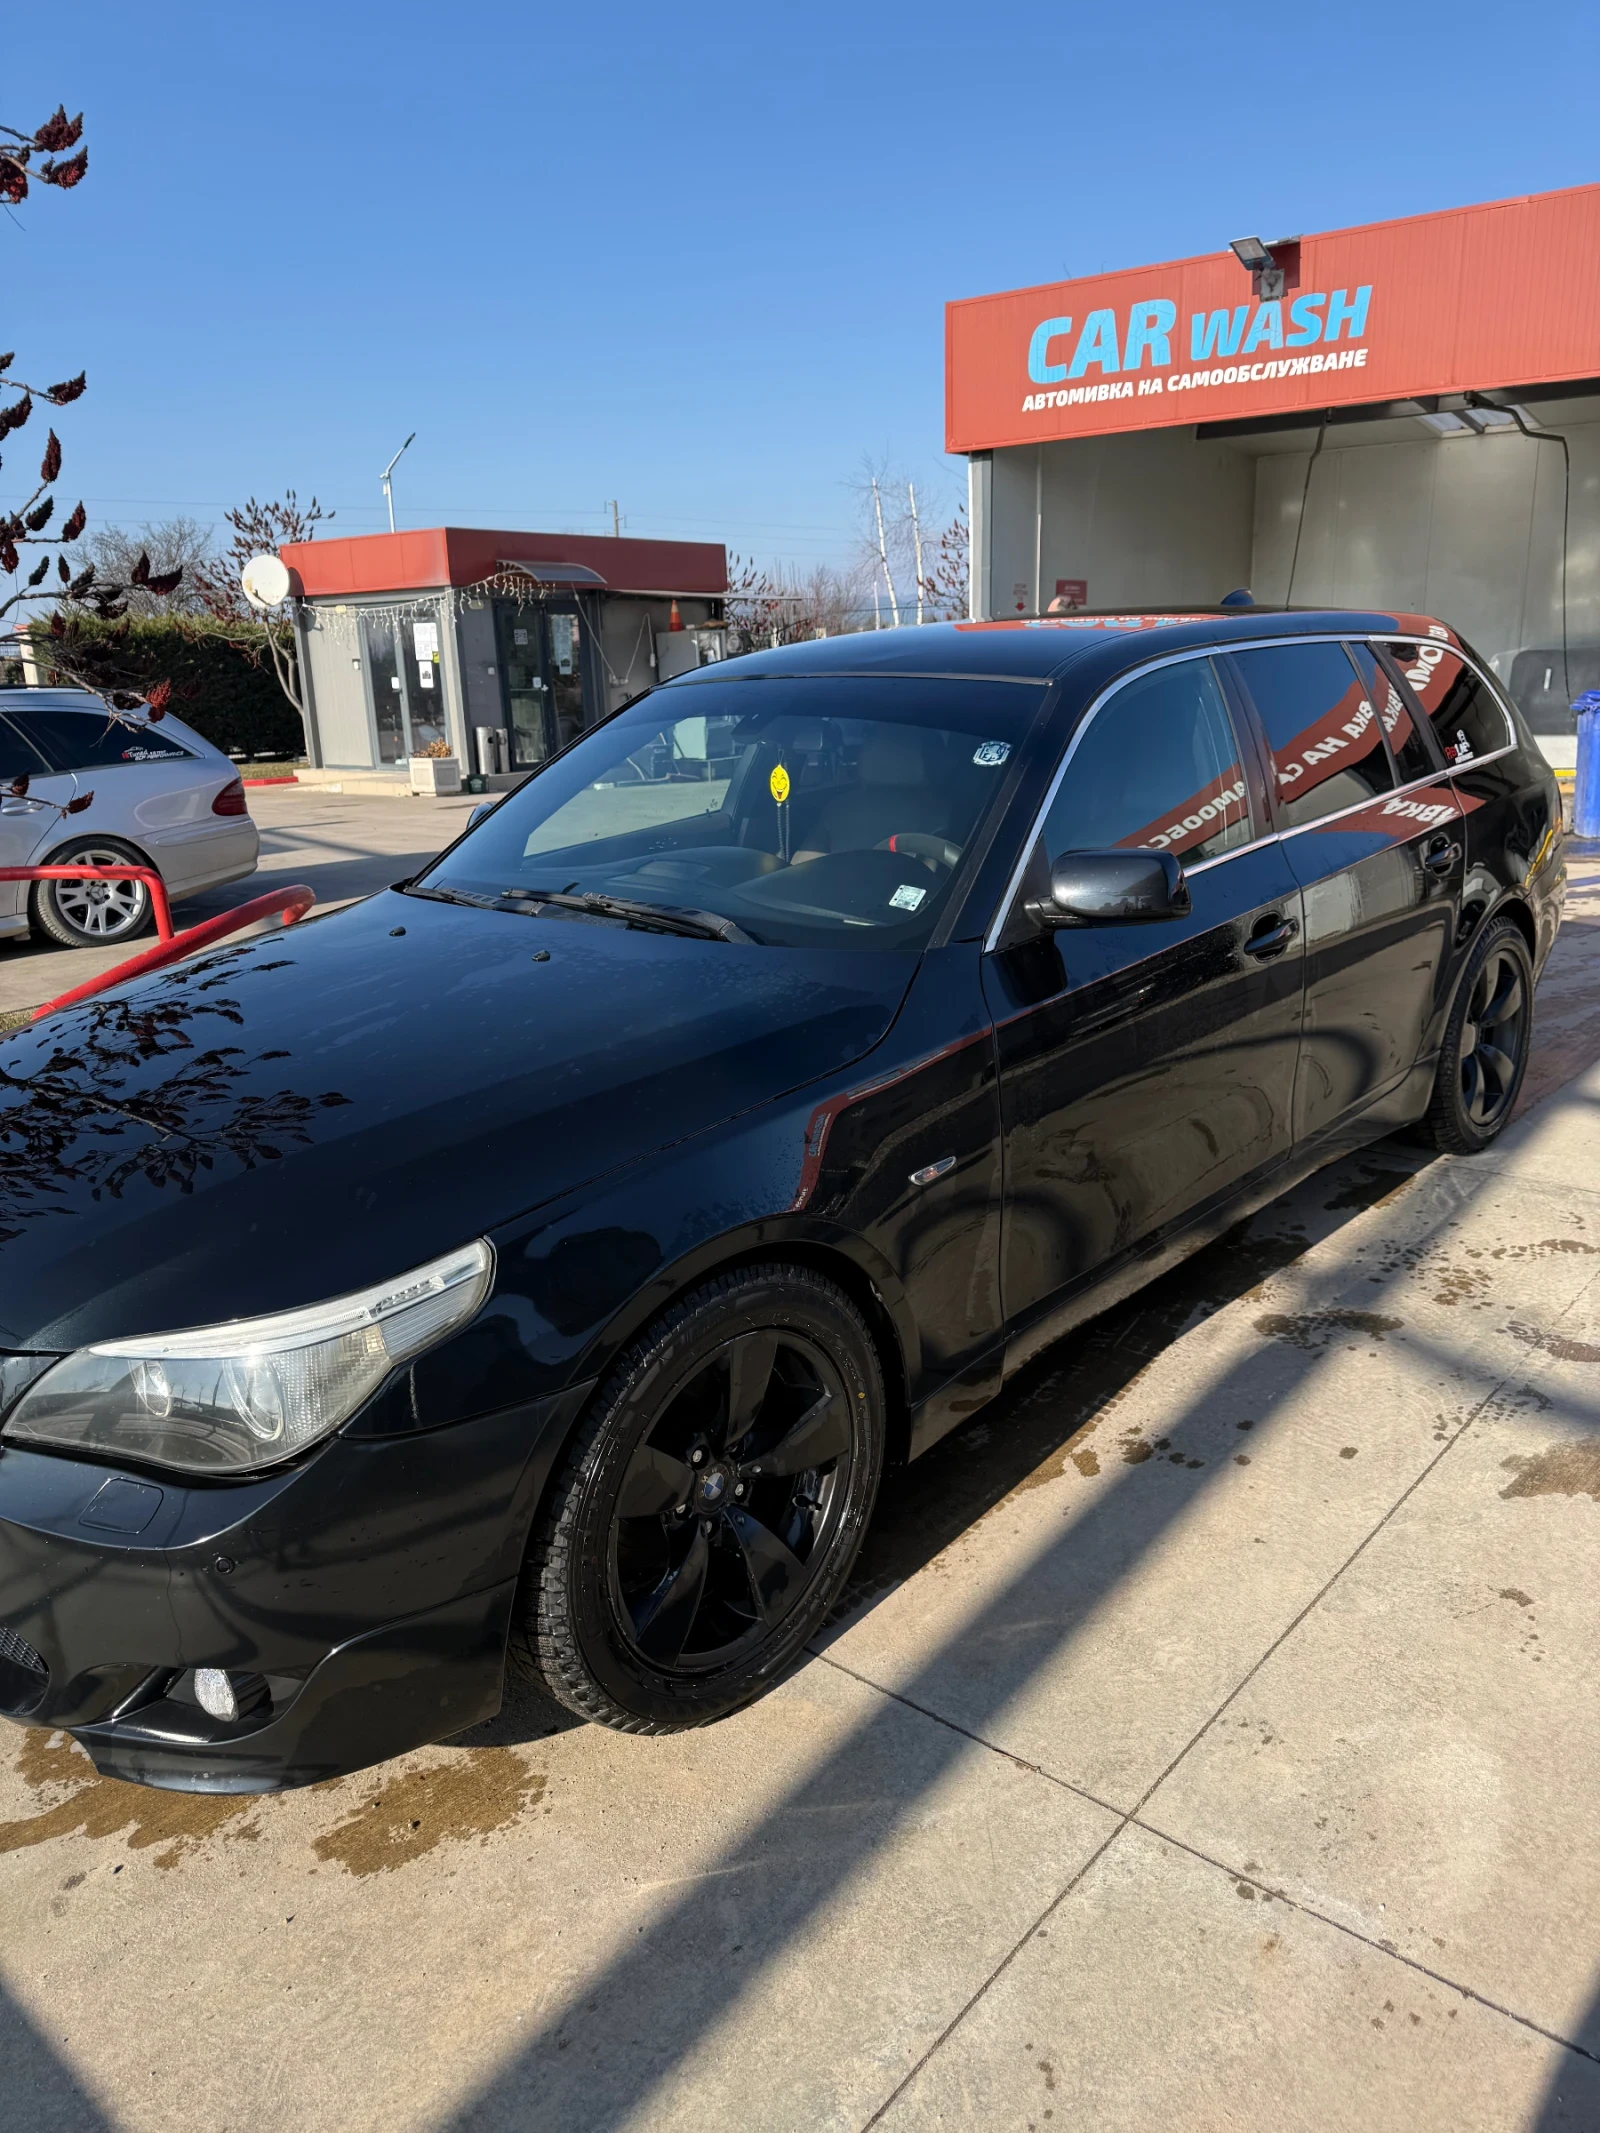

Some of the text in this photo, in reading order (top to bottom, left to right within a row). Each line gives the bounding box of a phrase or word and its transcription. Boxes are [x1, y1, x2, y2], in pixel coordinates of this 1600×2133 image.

[1027, 284, 1374, 385] CAR WASH
[1021, 348, 1369, 412] АВТОМИВКА НА САМООБСЛУЖВАНЕ
